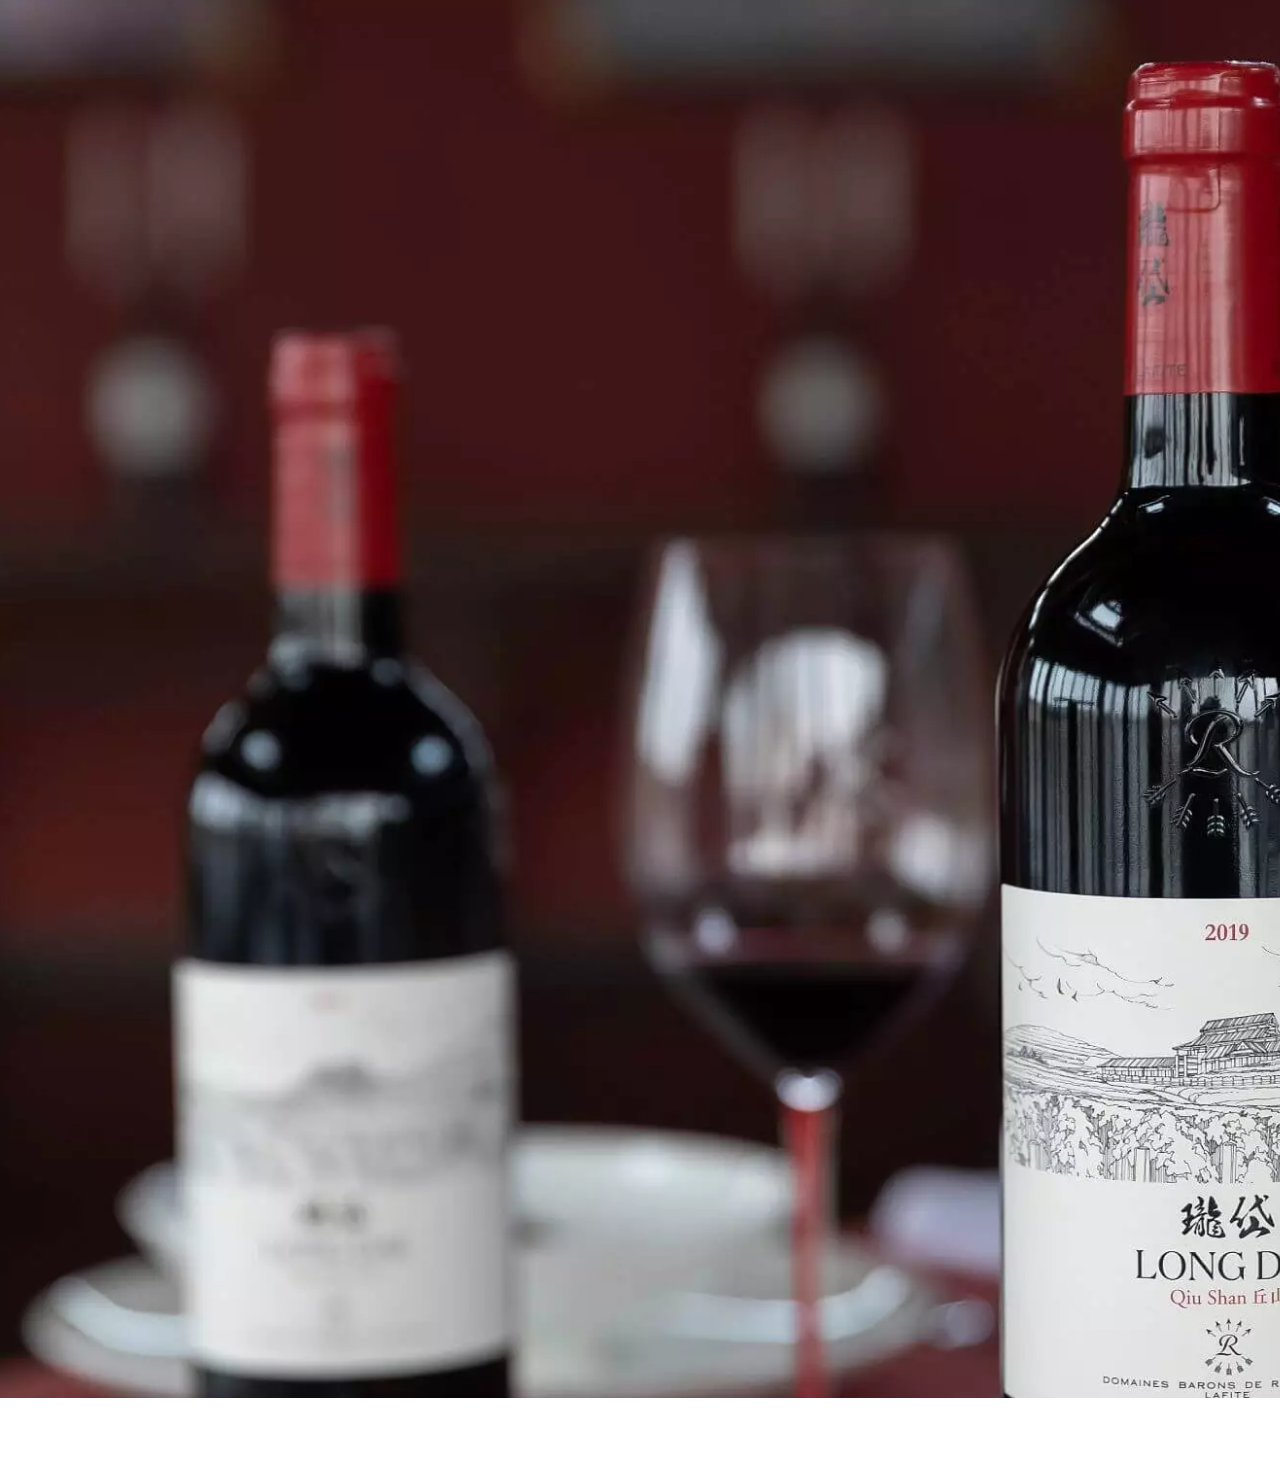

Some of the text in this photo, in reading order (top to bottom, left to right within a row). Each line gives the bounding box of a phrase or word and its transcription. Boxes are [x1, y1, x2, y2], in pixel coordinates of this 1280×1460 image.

[1204, 923, 1250, 942] 2019
[1136, 1249, 1246, 1281] LONG
[1170, 1289, 1202, 1309] Qiu
[1207, 1289, 1247, 1306] Shan
[1102, 1375, 1169, 1390] DOMAINES
[1178, 1381, 1236, 1390] BARONS
[1245, 1381, 1263, 1390] DE
